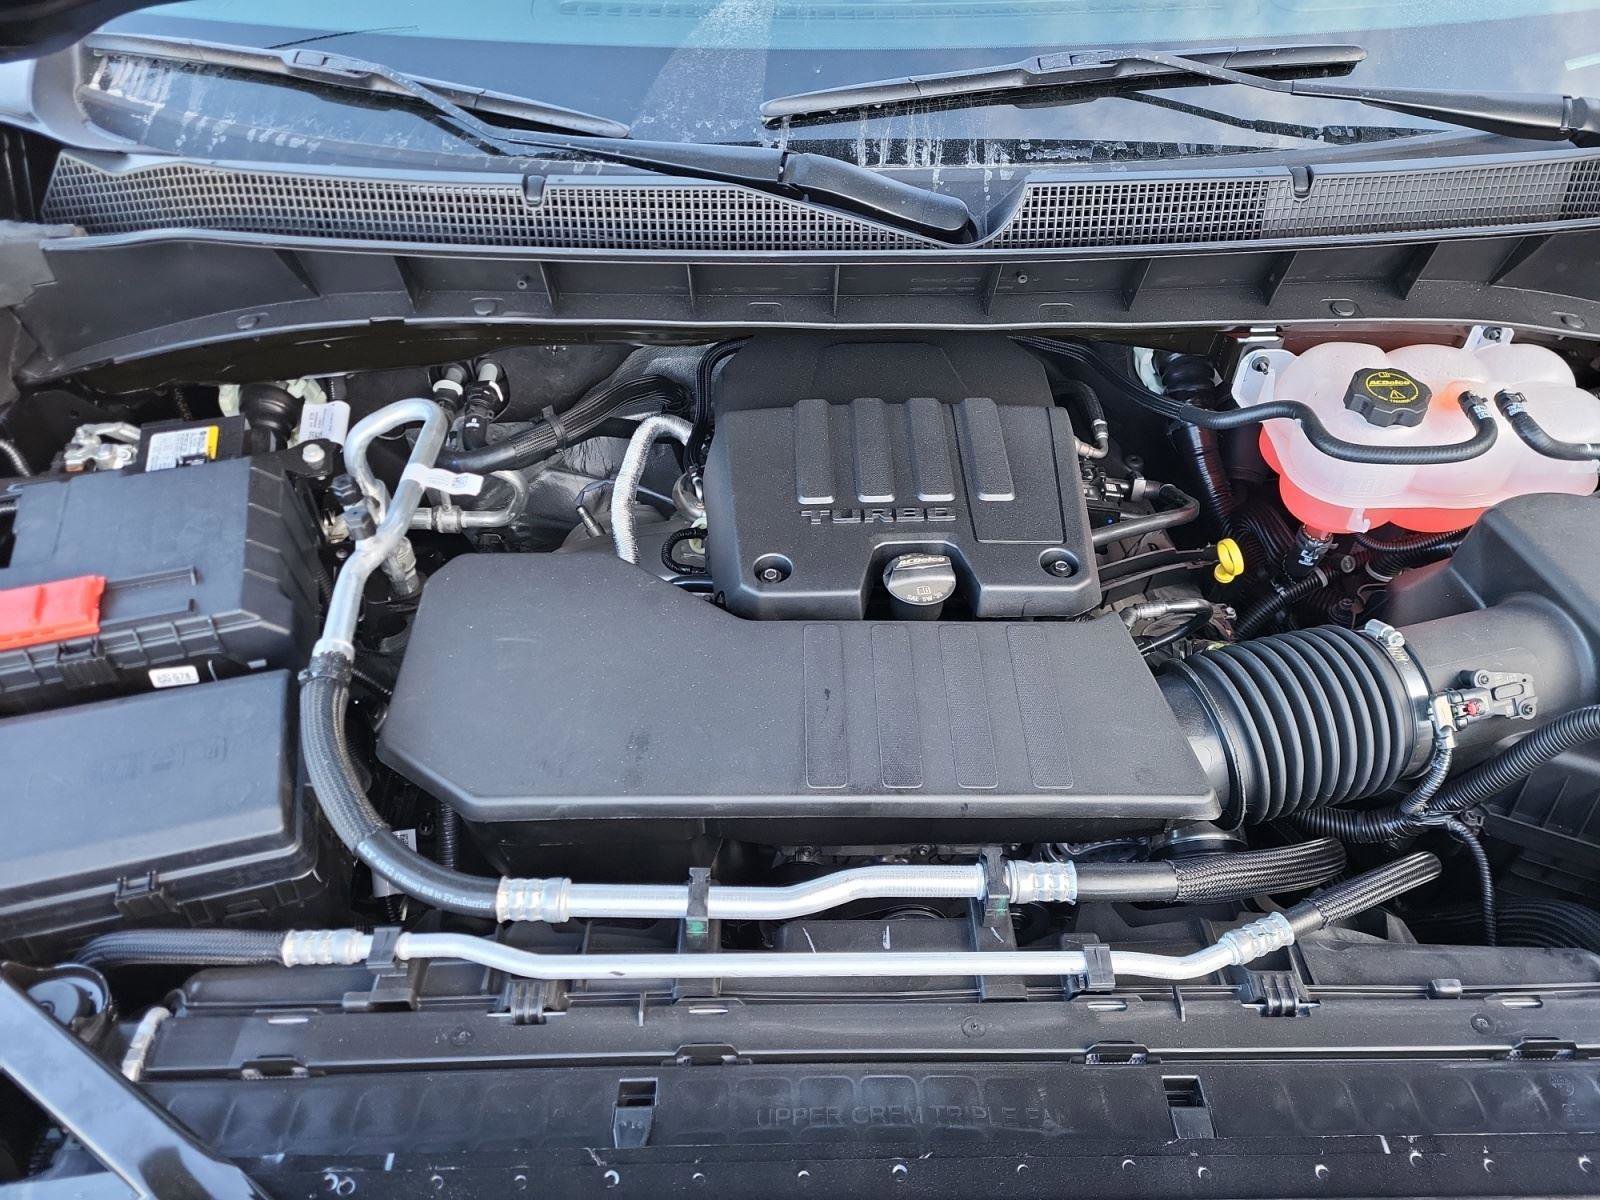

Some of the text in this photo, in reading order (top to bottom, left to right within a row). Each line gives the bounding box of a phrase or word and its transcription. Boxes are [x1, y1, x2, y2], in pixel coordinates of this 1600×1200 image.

[801, 507, 956, 525] TURBO
[896, 556, 946, 568] ACDelco
[756, 1106, 843, 1126] UPPER
